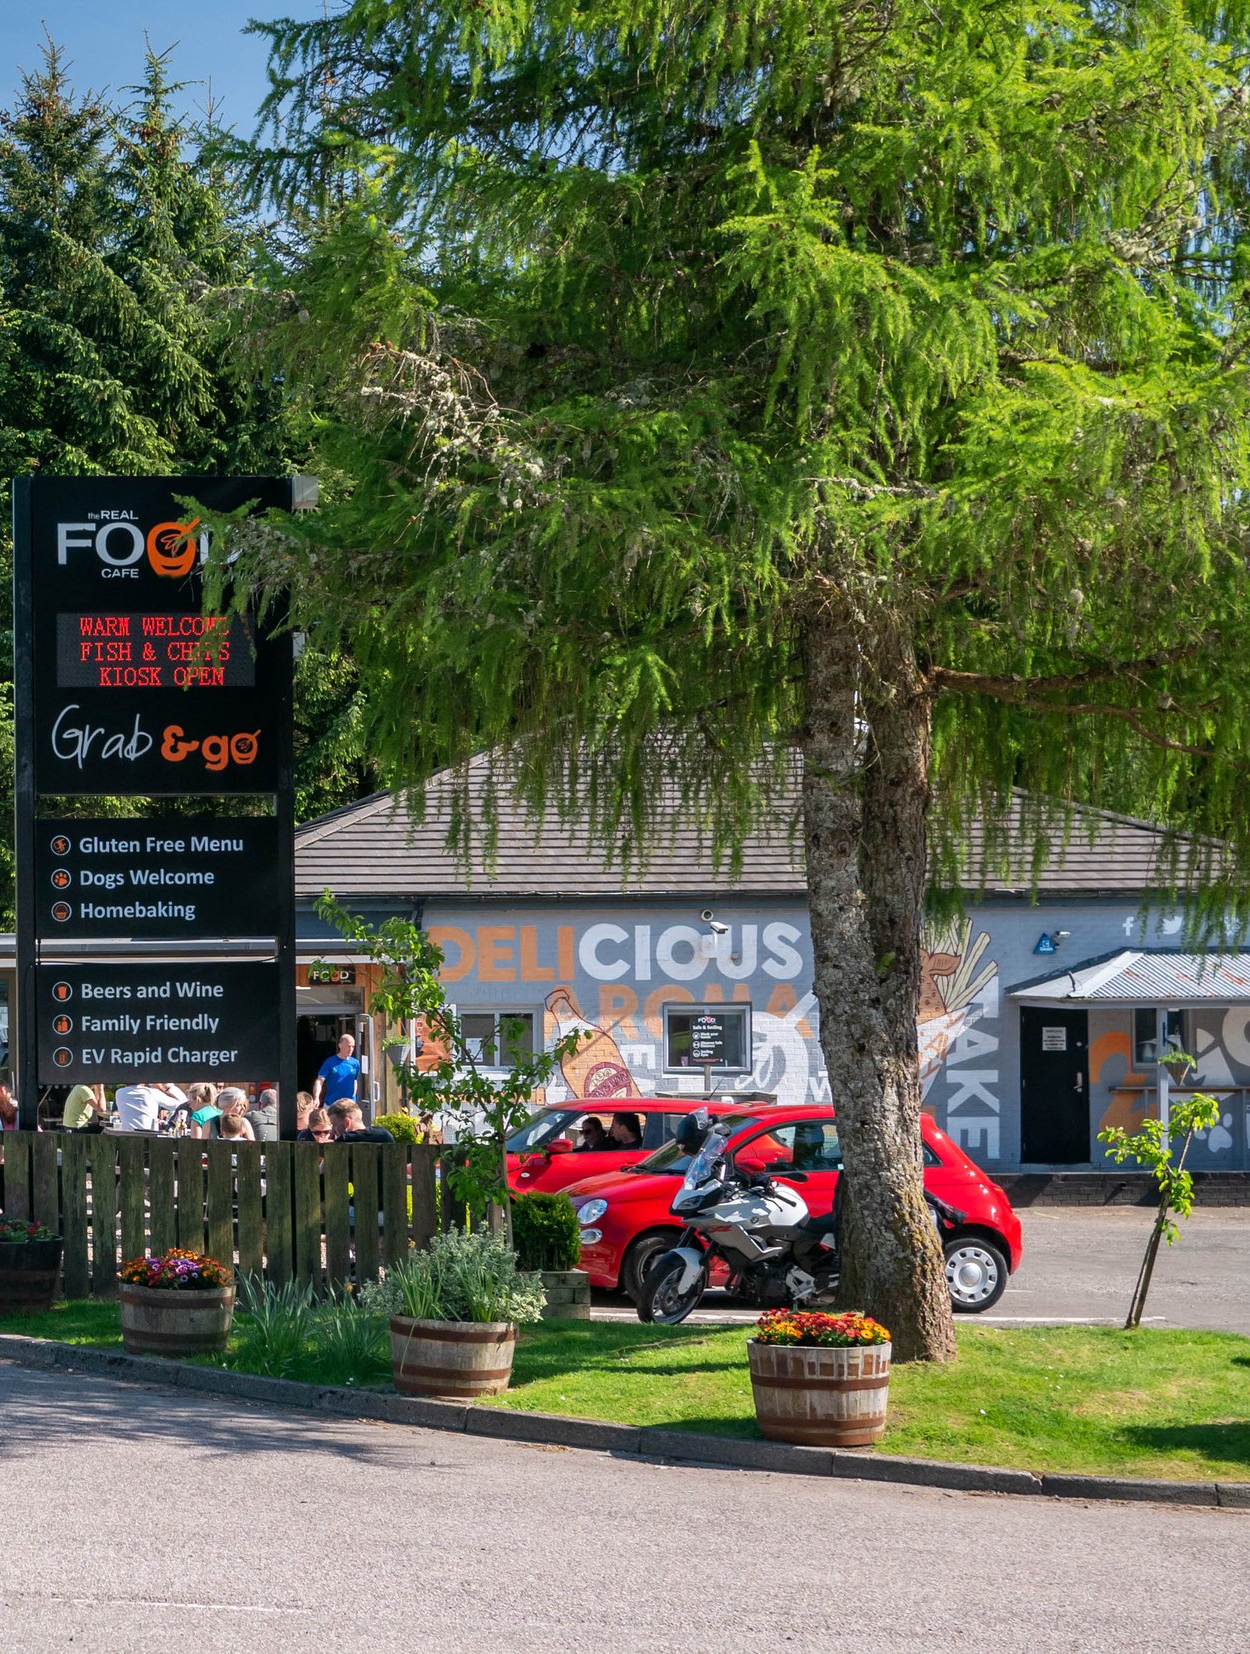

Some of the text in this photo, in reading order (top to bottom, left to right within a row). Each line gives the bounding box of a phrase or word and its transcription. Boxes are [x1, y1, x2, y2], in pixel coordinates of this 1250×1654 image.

[88, 510, 139, 520] the REAL
[101, 568, 139, 578] CAFE
[80, 617, 130, 636] WARM
[80, 643, 132, 662] FISH
[142, 642, 156, 661] &
[100, 667, 225, 686] KIOSK OPEN
[51, 704, 261, 771] Grab & go
[79, 836, 244, 854] Gluten Free Menu
[79, 868, 215, 889] Dogs Welcome
[80, 902, 196, 921] Homebaking
[424, 921, 803, 982] DELICIOUS
[81, 982, 224, 999] Beers and Wine
[81, 1014, 219, 1034] Family Friendly
[81, 1047, 239, 1067] EV Rapid Charger
